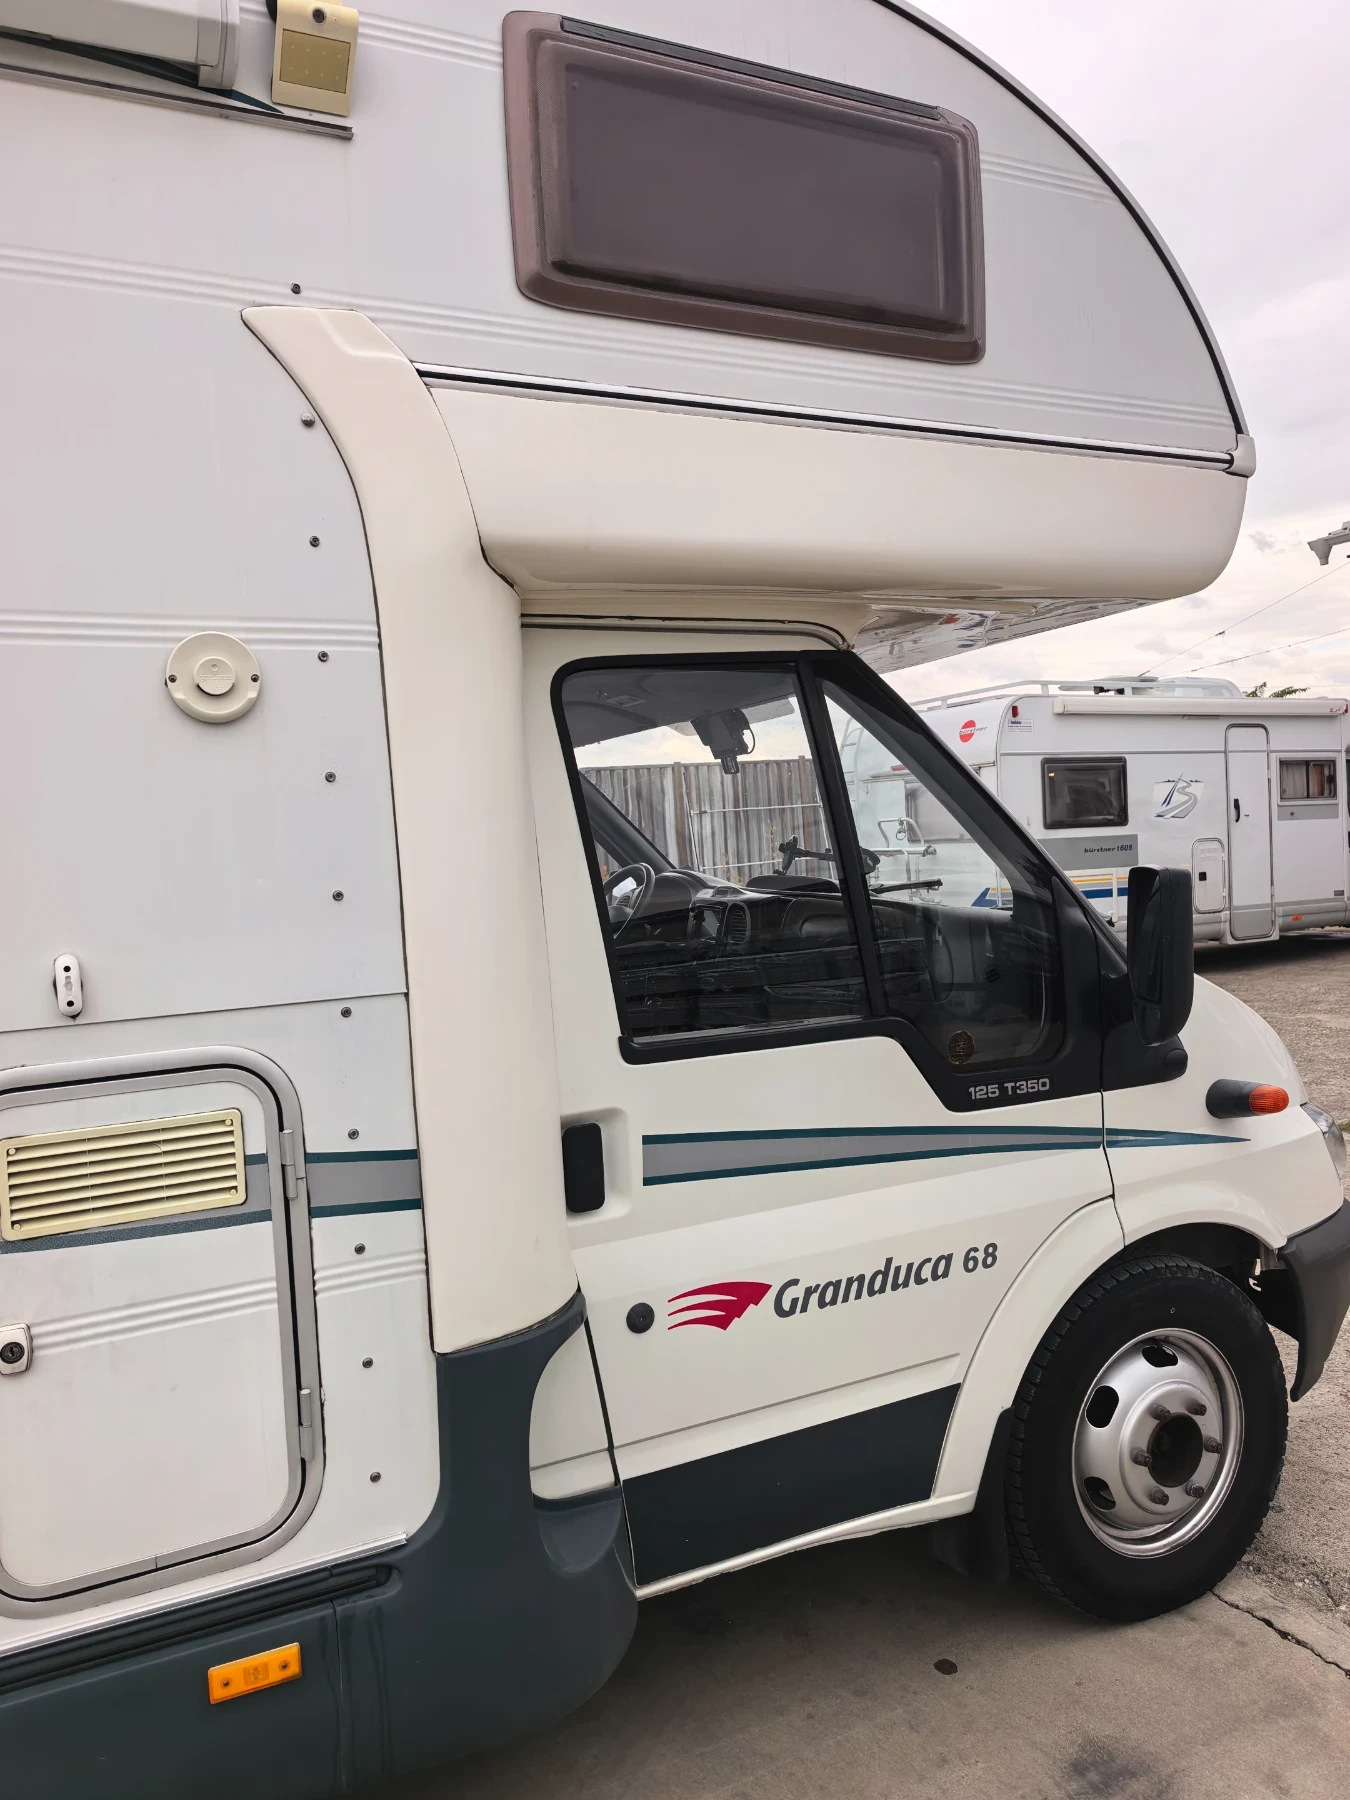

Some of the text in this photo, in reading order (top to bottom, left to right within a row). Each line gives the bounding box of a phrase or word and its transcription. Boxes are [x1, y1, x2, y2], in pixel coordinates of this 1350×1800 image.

[968, 1078, 1050, 1100] 125 T350
[773, 1242, 998, 1318] Granduca 68
